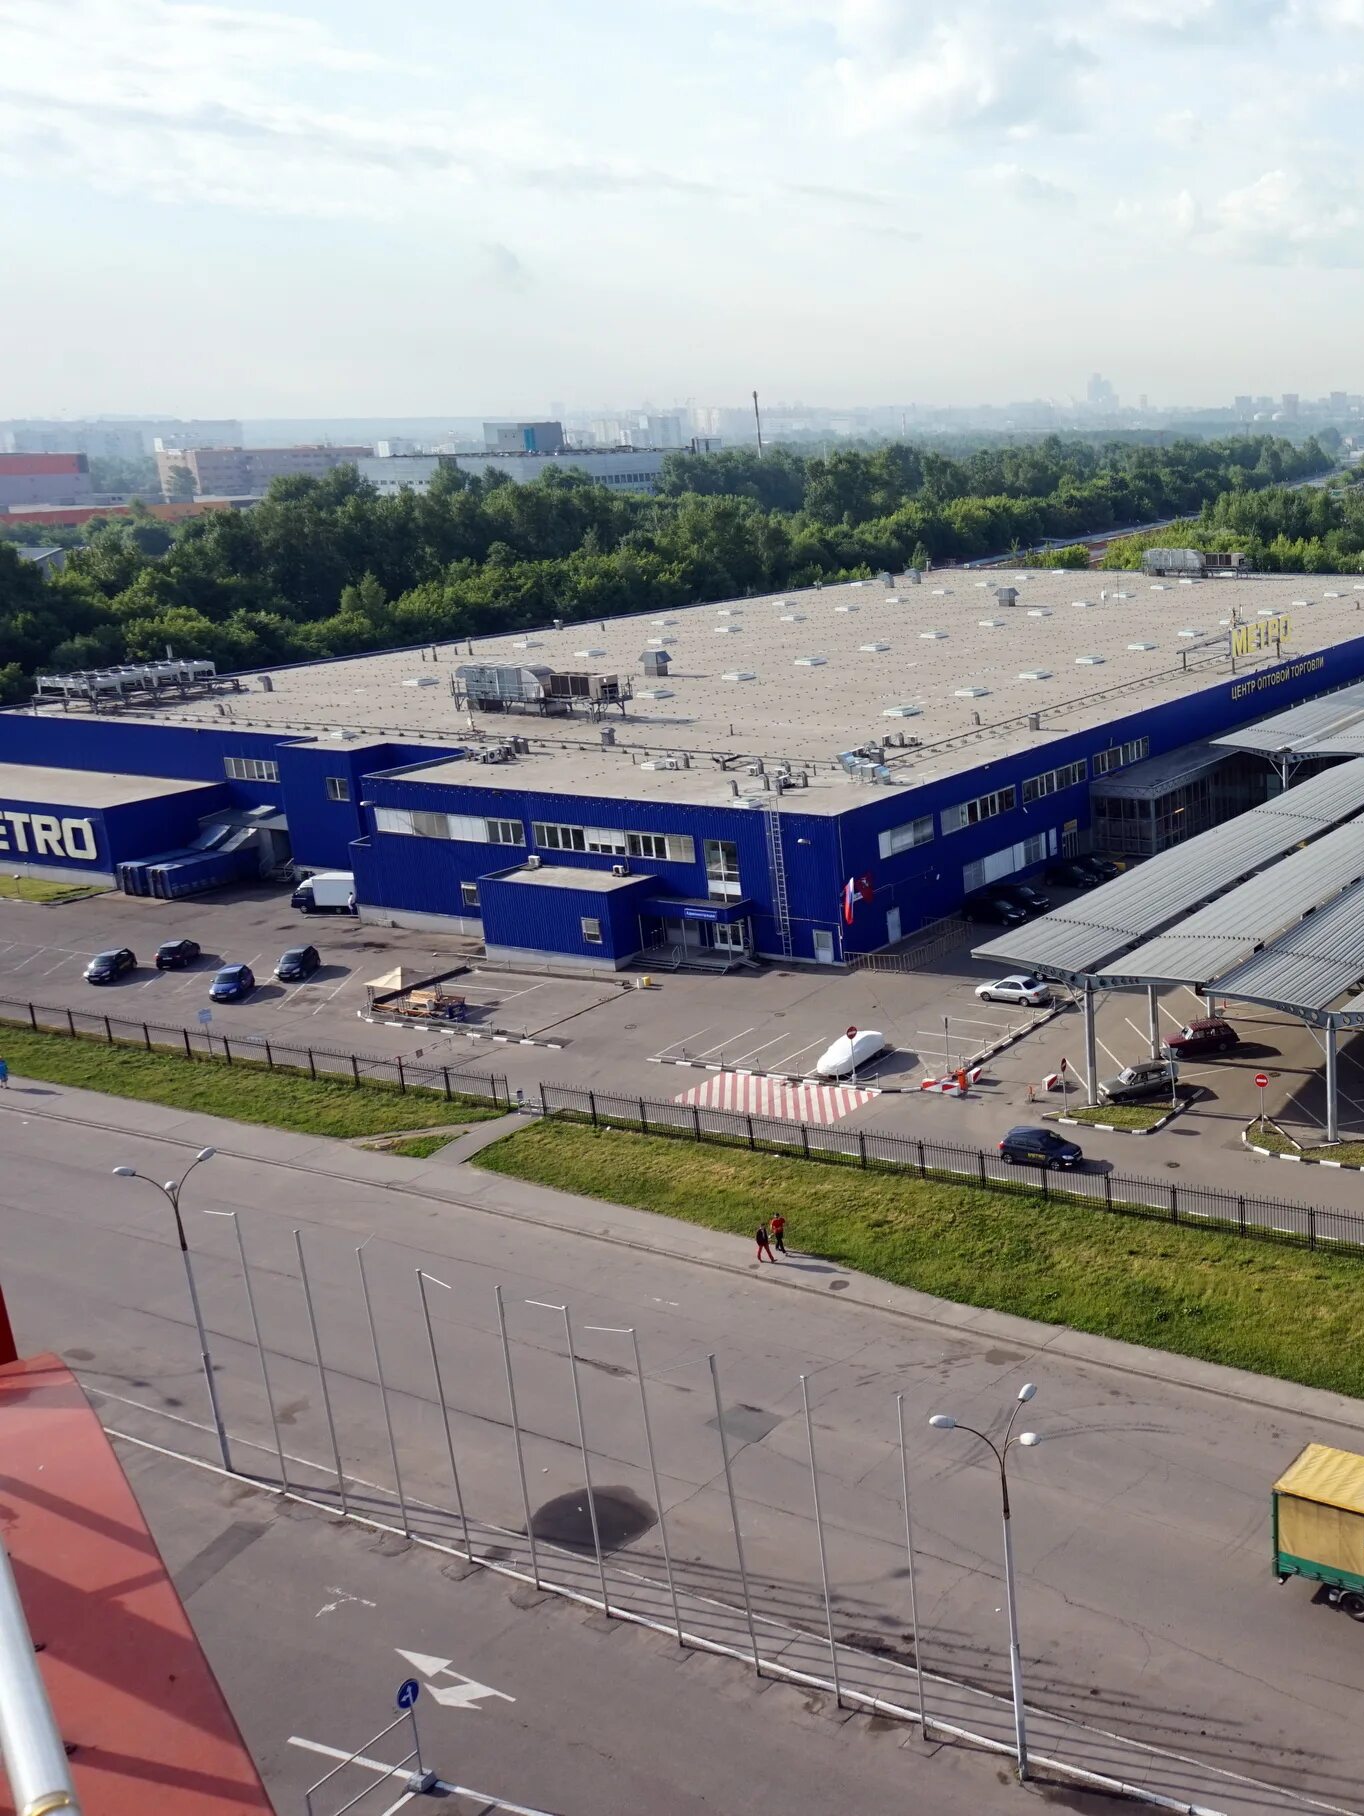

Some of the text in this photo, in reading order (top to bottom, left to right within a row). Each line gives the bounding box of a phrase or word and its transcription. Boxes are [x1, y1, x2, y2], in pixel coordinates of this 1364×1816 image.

[1231, 614, 1292, 657] МЕТРО
[1231, 656, 1324, 701] ЦЕНТР ОПТОВОЙ ТОРГОВЛИ
